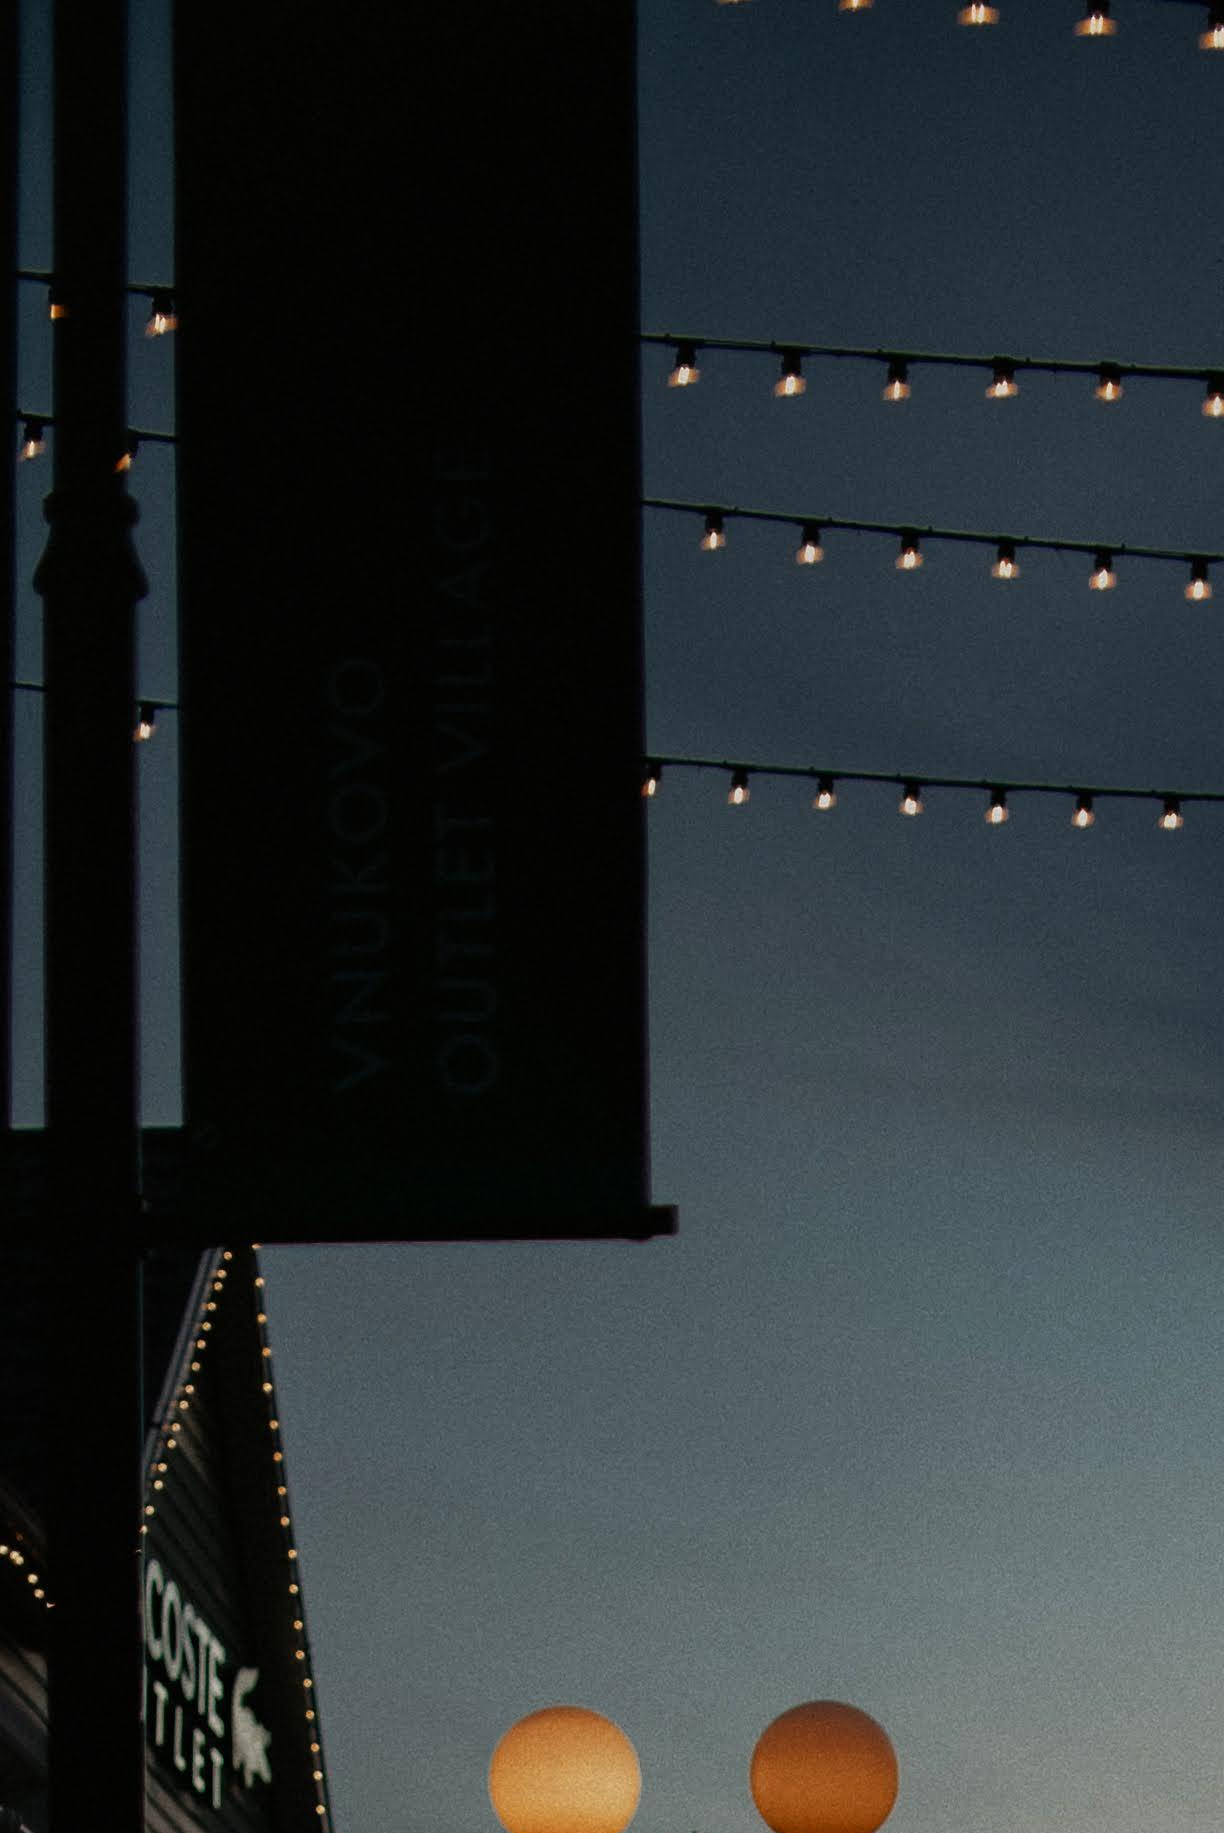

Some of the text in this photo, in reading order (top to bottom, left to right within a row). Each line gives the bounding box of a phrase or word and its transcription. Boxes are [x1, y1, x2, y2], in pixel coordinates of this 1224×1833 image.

[328, 656, 391, 1094] VNUKOVO
[434, 442, 498, 1097] OUTLET VILLAGE
[145, 1558, 226, 1739] COSTE
[151, 1679, 223, 1809] TLET
